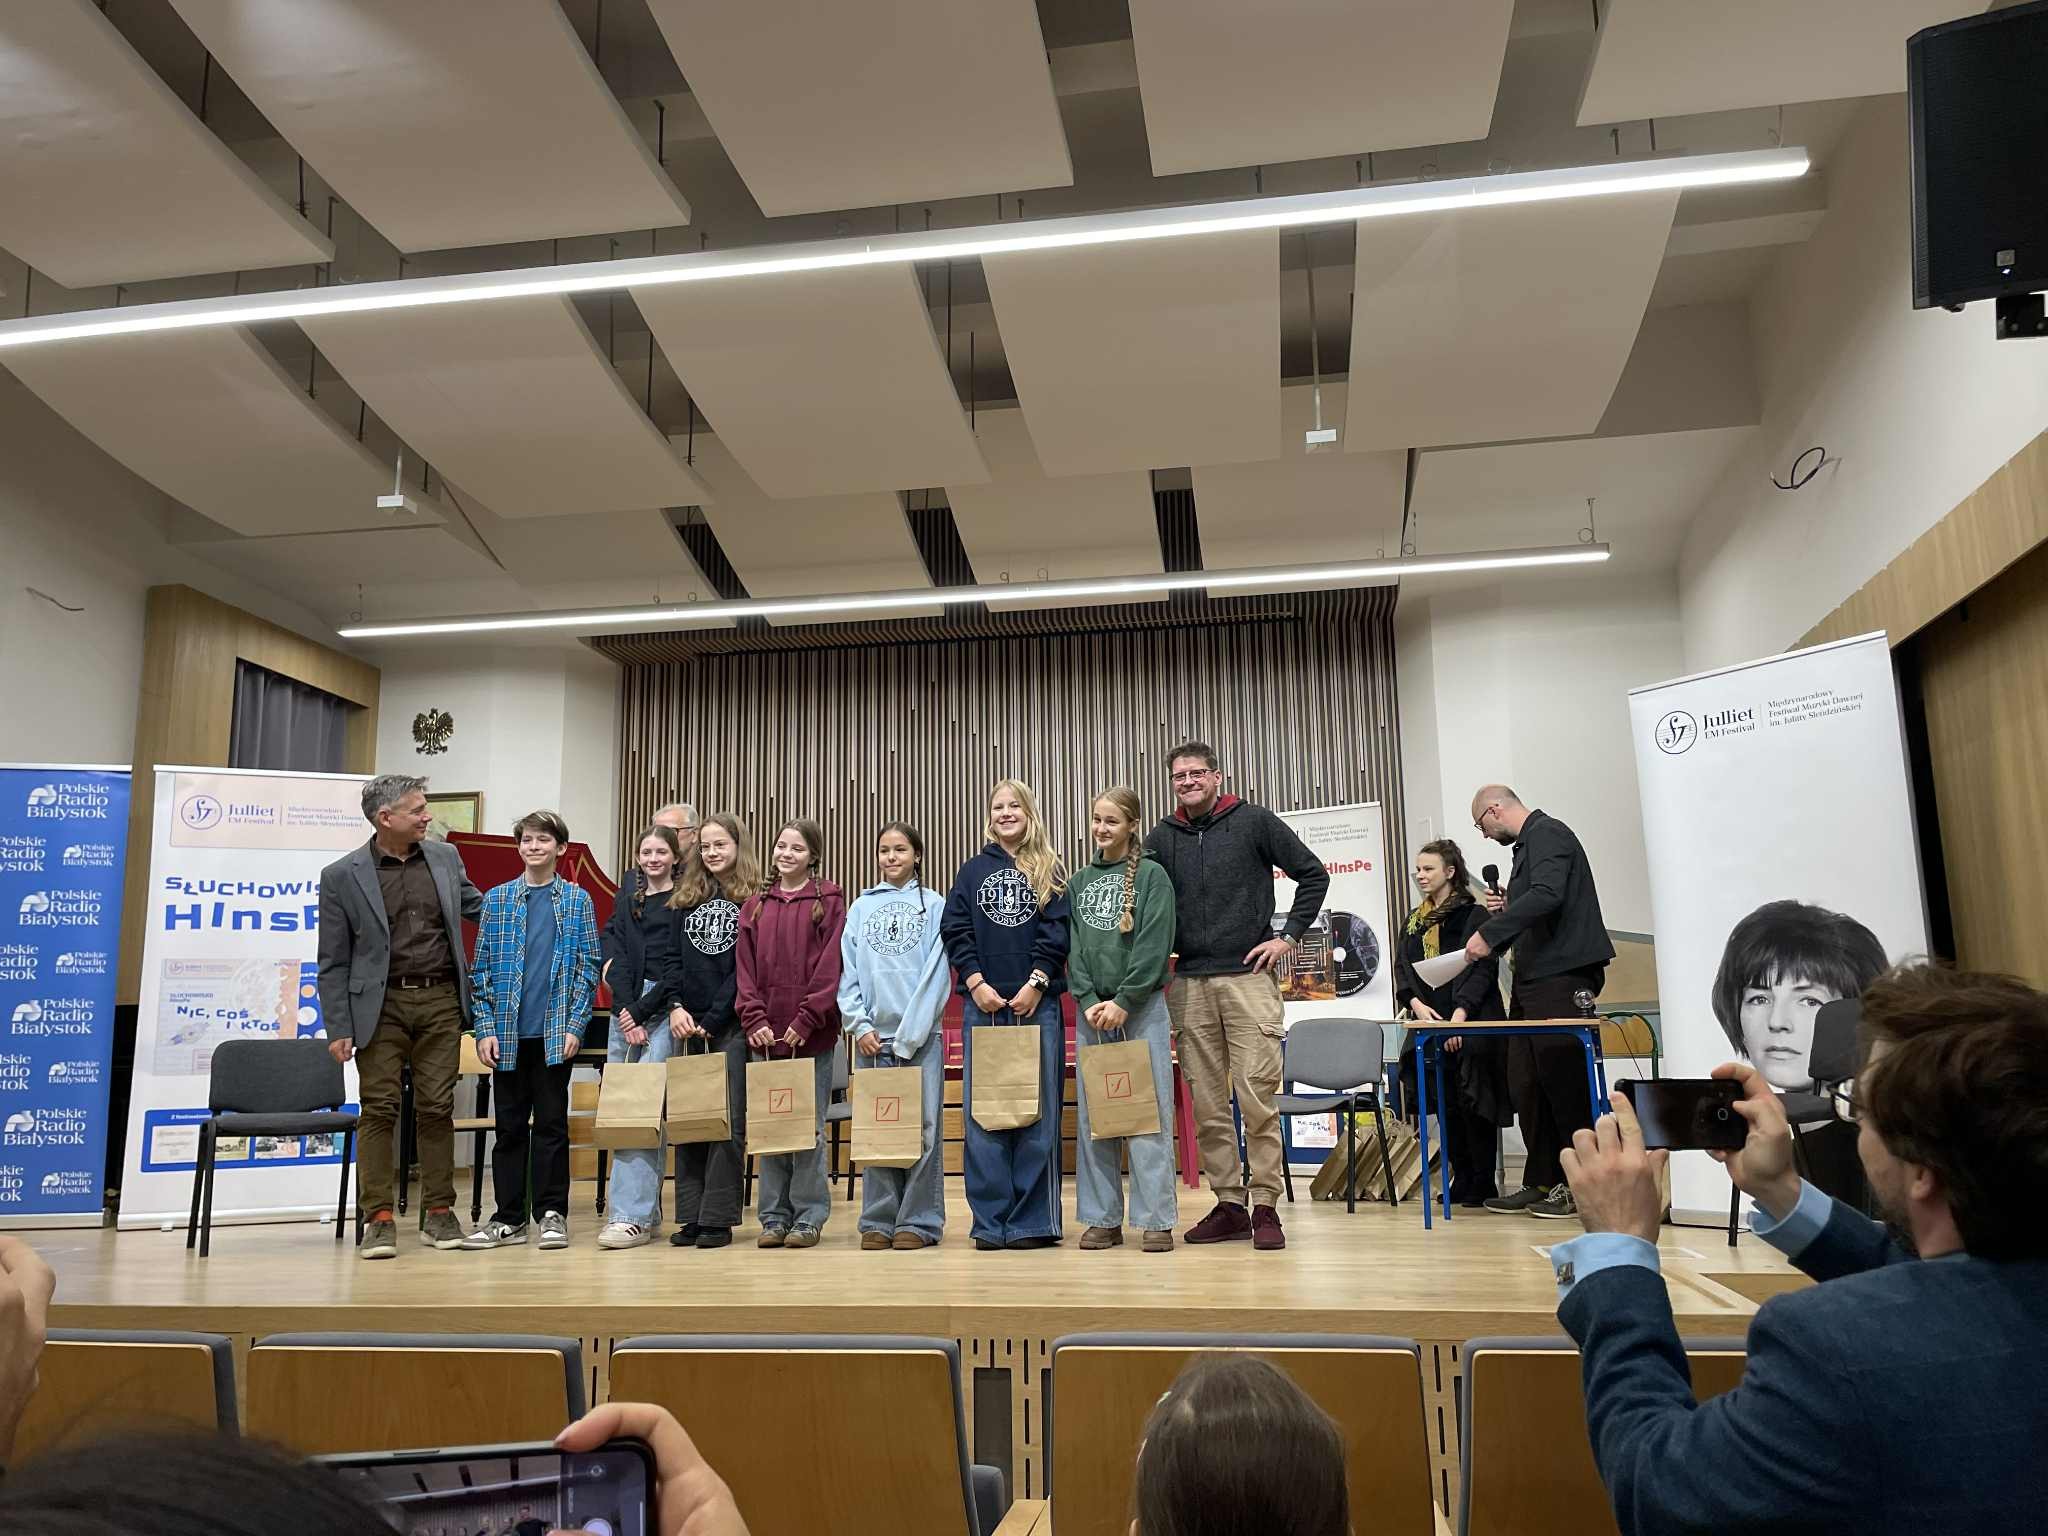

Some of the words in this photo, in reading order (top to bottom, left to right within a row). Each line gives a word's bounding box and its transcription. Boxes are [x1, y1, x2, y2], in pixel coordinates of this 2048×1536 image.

[1704, 707, 1754, 731] Julliet
[1721, 723, 1755, 736] Festival
[59, 784, 110, 794] Polskie
[58, 794, 109, 806] Radio
[229, 804, 274, 816] Julliet
[0, 860, 44, 872] ystok
[51, 890, 102, 900] Polskie
[50, 901, 101, 912] Radio
[165, 902, 320, 931] HInsP
[0, 944, 39, 954] olskie
[0, 955, 38, 967] adio
[44, 998, 95, 1009] Polskie
[43, 1009, 94, 1021] Radio
[177, 1006, 210, 1018] NIC,
[216, 1008, 249, 1019] COŚ
[241, 1020, 281, 1031] KTOŚ
[0, 1065, 31, 1077] dio
[36, 1108, 87, 1118] Polskie
[35, 1119, 86, 1131] Radio
